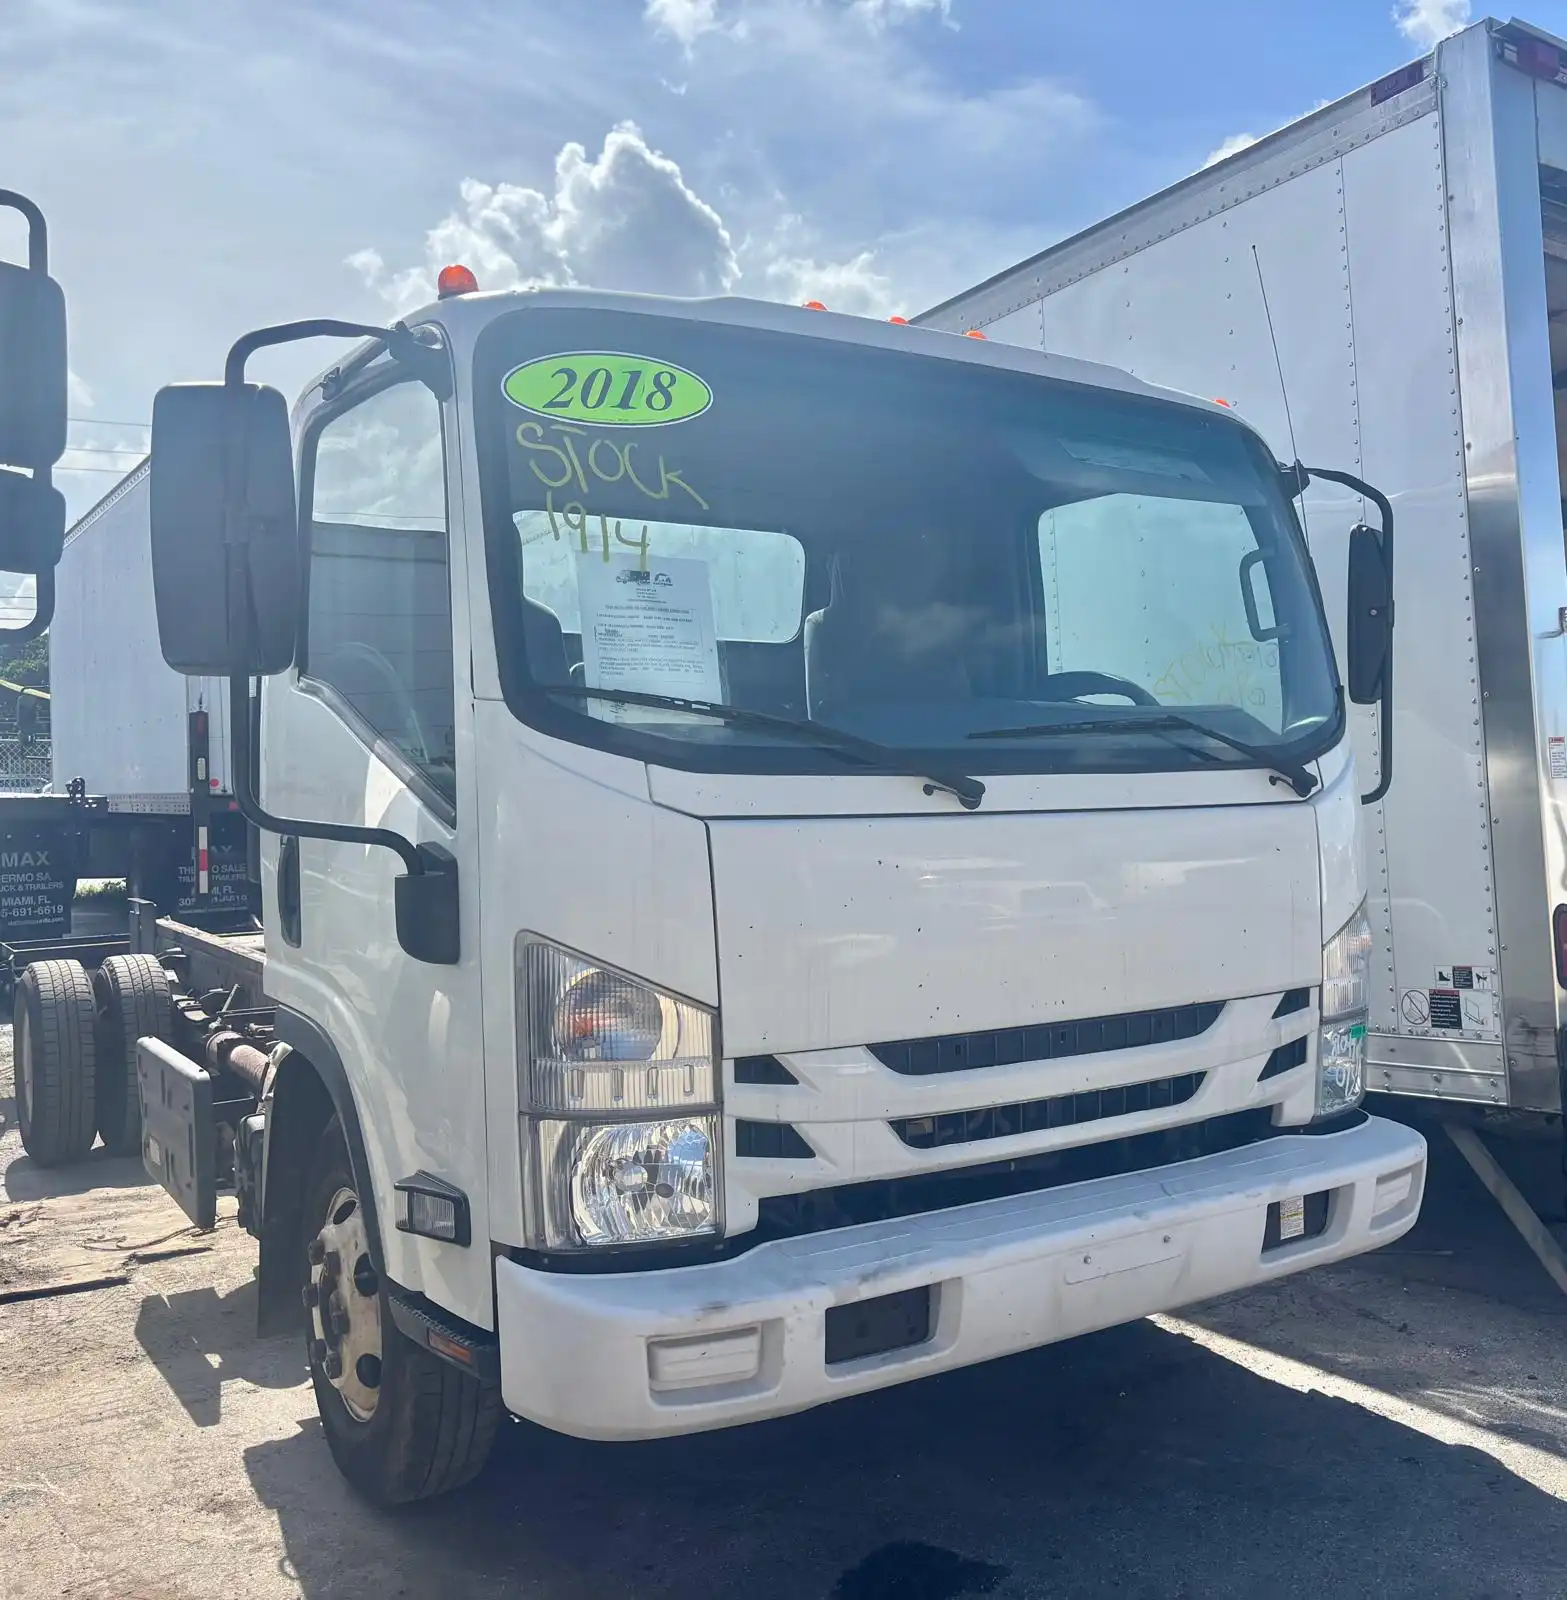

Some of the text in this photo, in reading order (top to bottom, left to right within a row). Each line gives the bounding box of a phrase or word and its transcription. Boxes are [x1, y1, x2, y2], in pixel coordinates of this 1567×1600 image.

[542, 367, 677, 411] 2018
[546, 491, 651, 572] 1914
[1, 850, 51, 868] MAX
[0, 872, 35, 884] ERMO
[1, 895, 52, 907] MIAMI, FL
[0, 904, 65, 918] 5-691-6619
